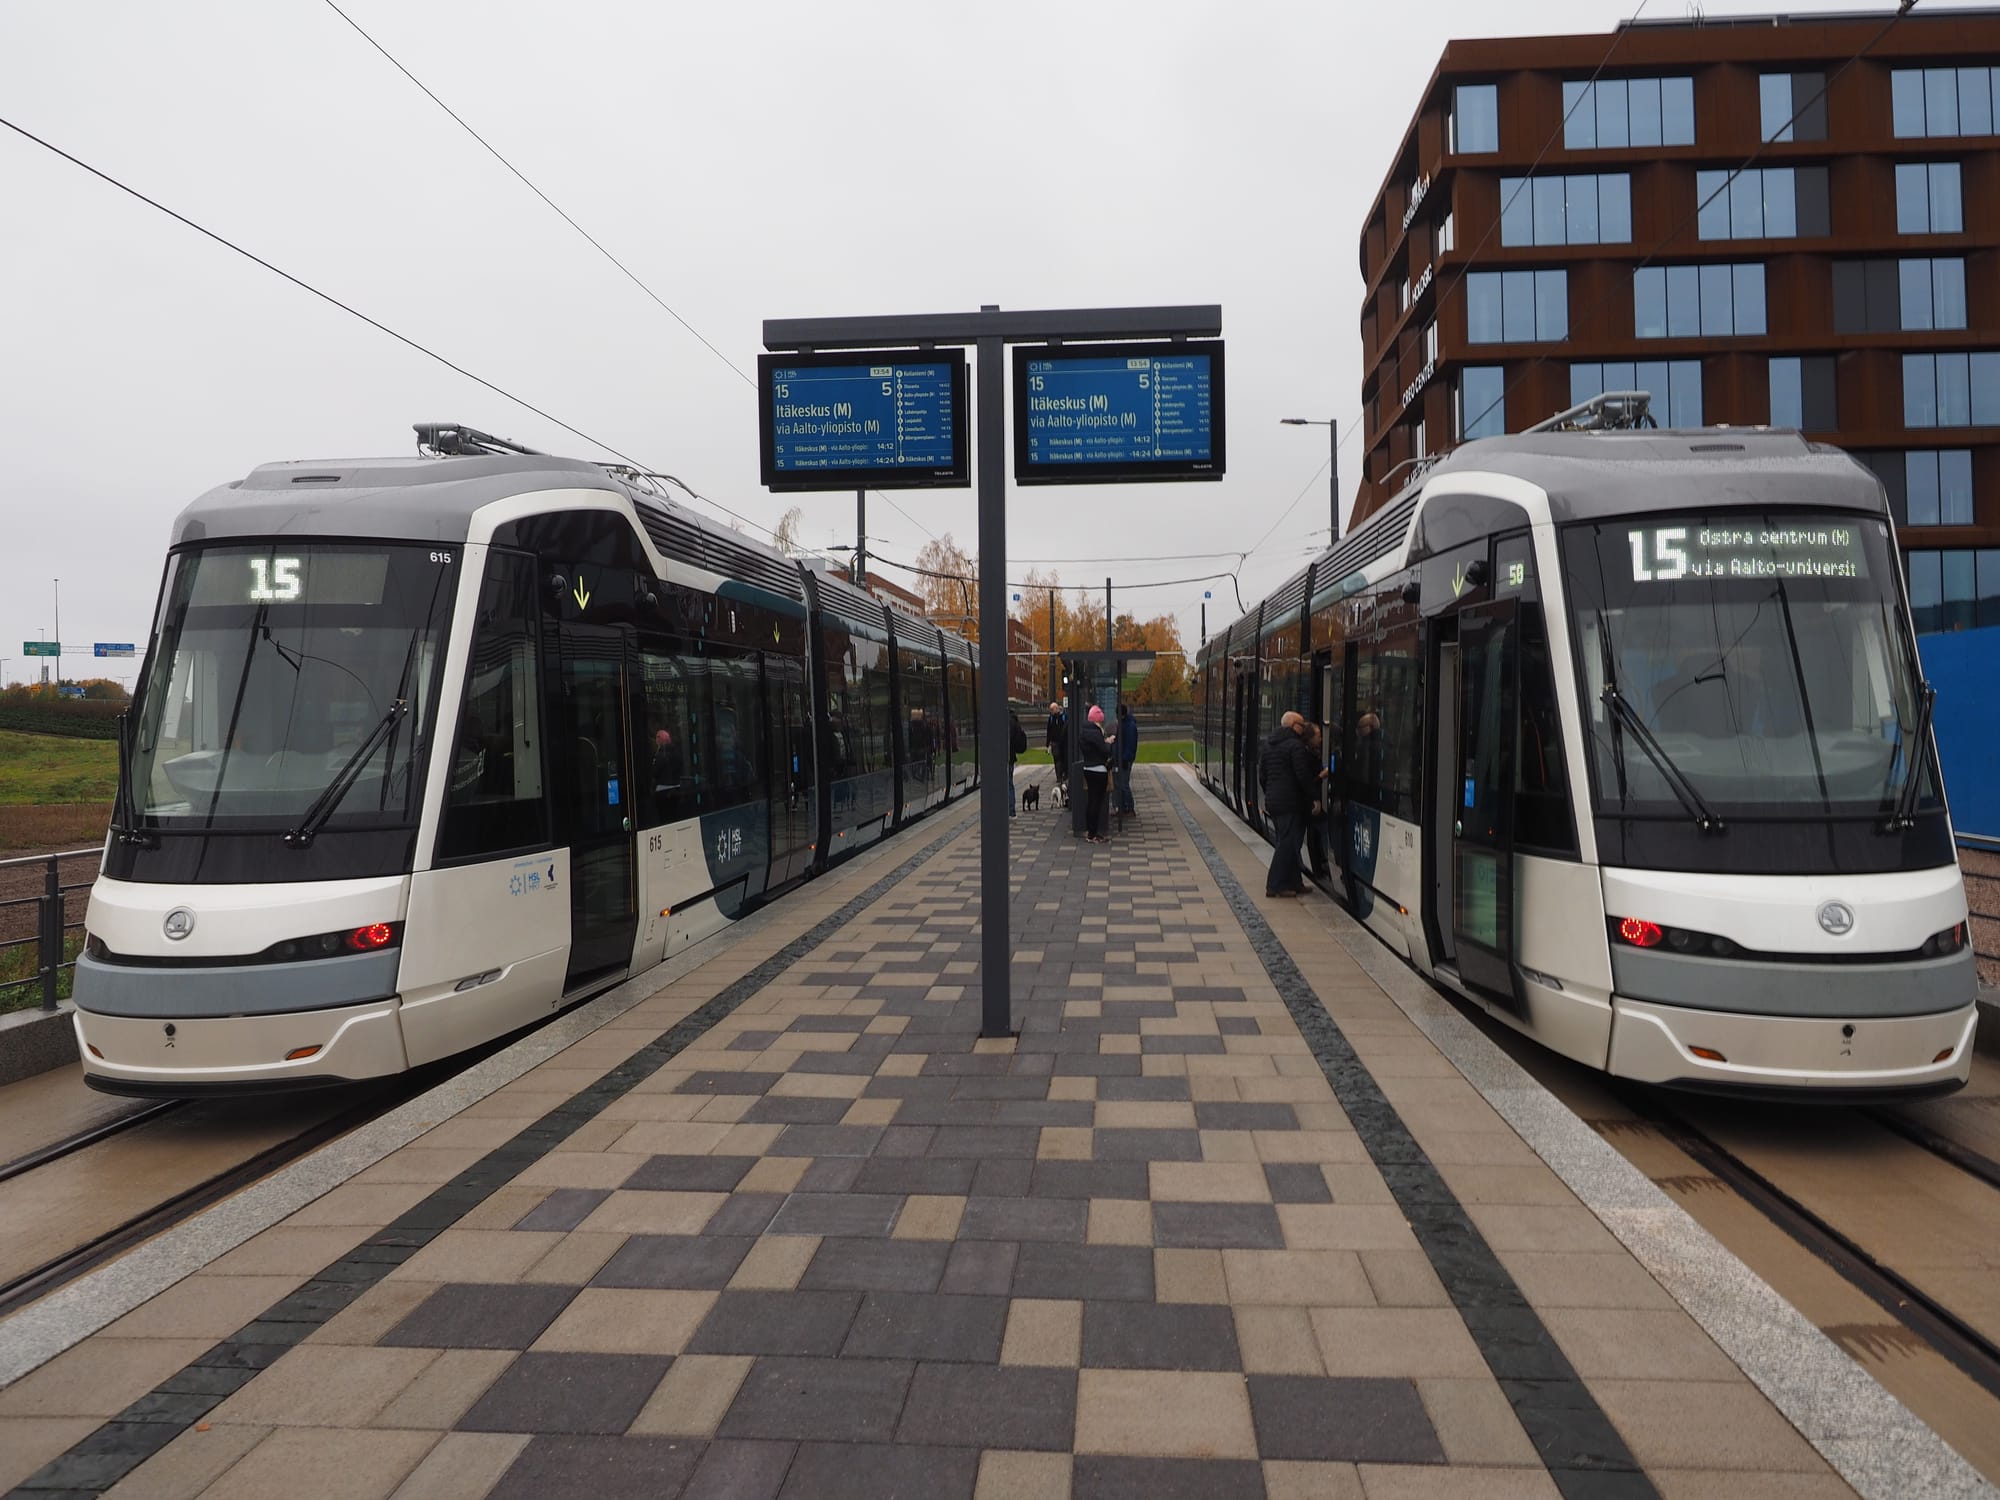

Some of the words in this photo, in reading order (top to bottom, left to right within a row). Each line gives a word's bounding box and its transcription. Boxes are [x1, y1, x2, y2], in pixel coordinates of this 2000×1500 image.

[881, 382, 892, 396] 5
[1029, 376, 1044, 391] 15
[1138, 374, 1150, 388] 5
[775, 384, 789, 399] 15
[776, 404, 830, 418] Itäkeskus
[833, 402, 852, 419] (M)
[1030, 396, 1086, 411] Itäkeskus
[1089, 394, 1108, 412] (M)
[776, 423, 791, 435] via
[793, 420, 861, 436] Aalto-yliopisto
[864, 420, 880, 435] (M)
[1030, 415, 1045, 428] via
[1047, 413, 1118, 430] Aalto-yliopisto
[1120, 412, 1137, 428] (M)
[1030, 439, 1039, 447] 15
[1030, 453, 1039, 461] 15
[1759, 530, 1828, 546] centrum
[1831, 528, 1850, 547] (M)
[430, 552, 452, 563] 615
[1628, 528, 1687, 582] 15
[1691, 558, 1724, 577] via
[1730, 558, 1856, 577] Aalto-universit
[250, 558, 301, 600] 15
[650, 834, 662, 852] 615
